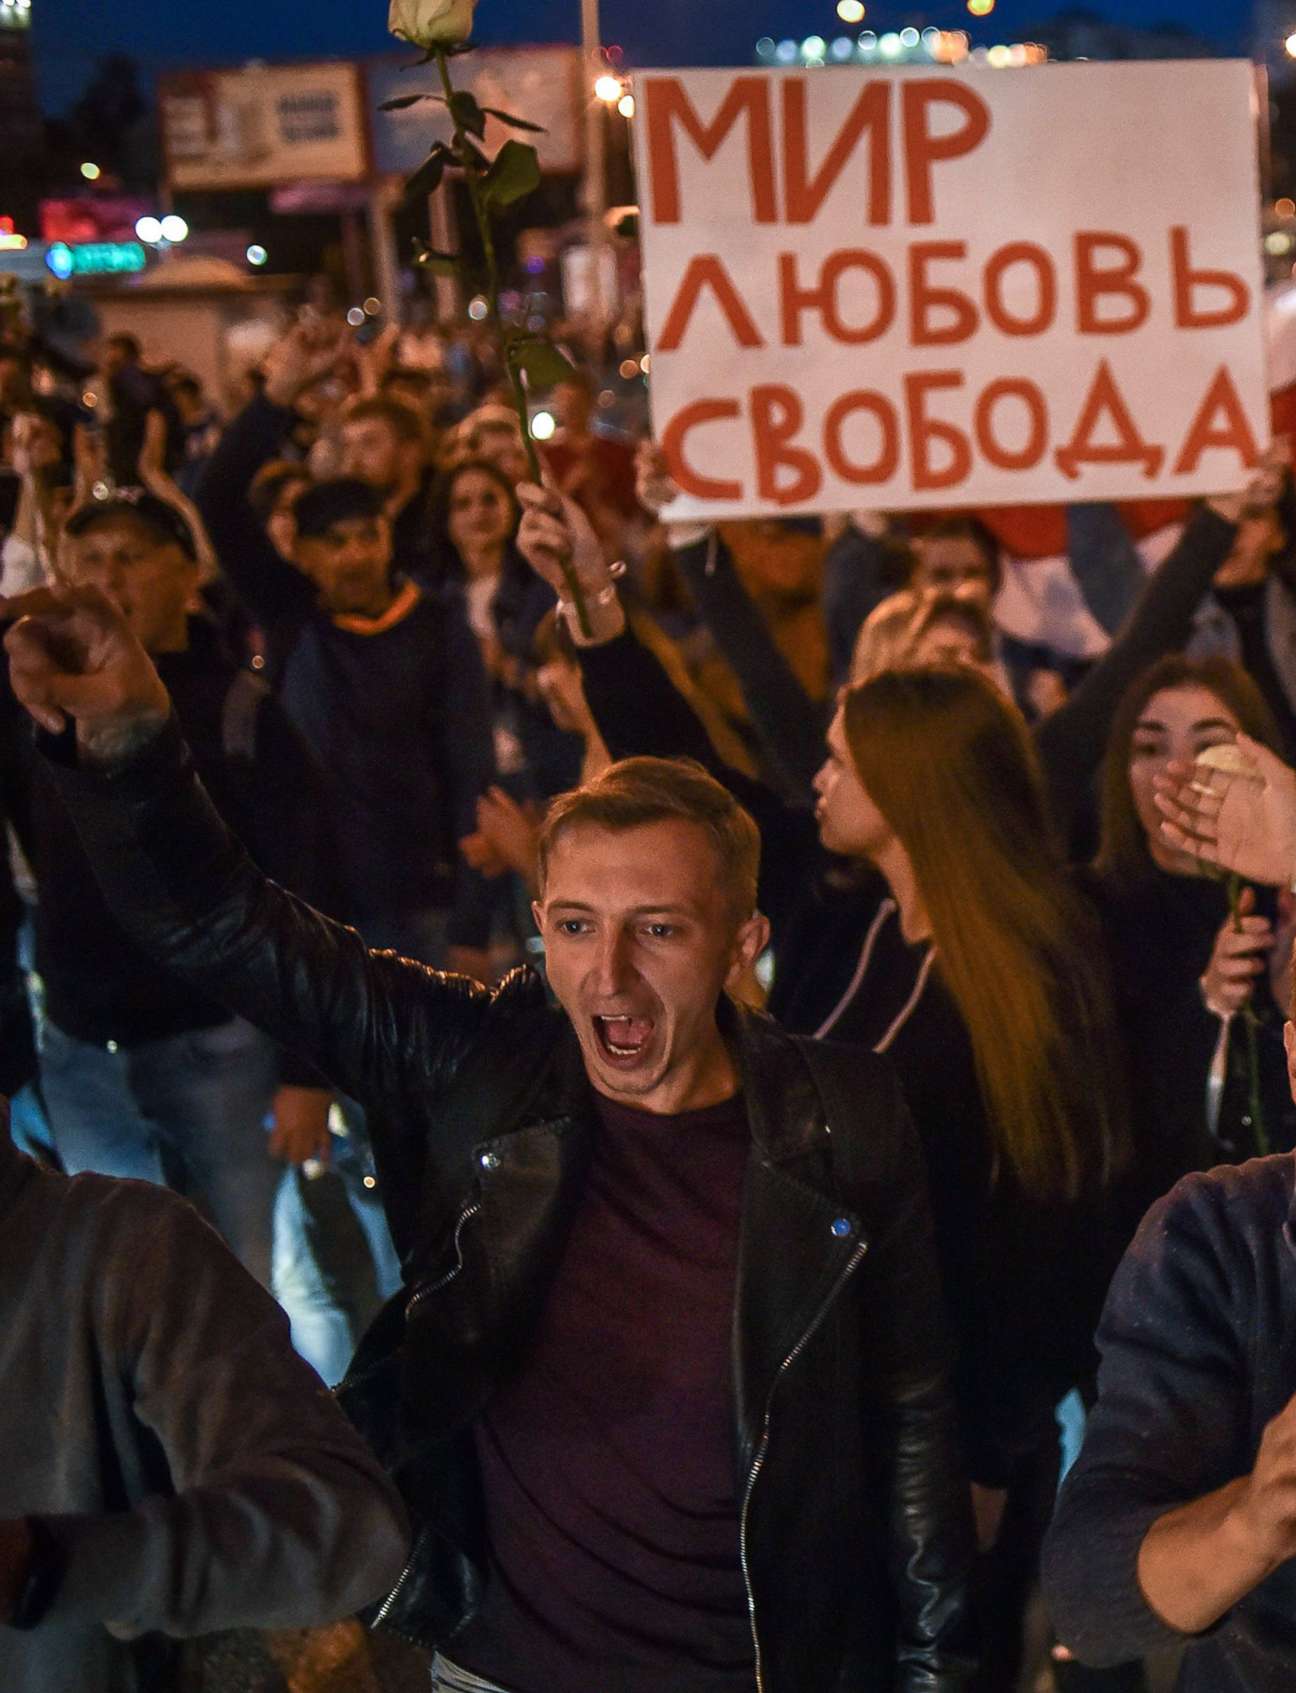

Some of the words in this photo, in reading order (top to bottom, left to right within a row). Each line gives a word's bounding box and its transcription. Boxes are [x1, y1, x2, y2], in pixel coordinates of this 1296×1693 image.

[645, 77, 991, 226] МИР
[656, 225, 1251, 354] ЛЮБОВЬ
[660, 358, 1262, 506] СВОБОДА
